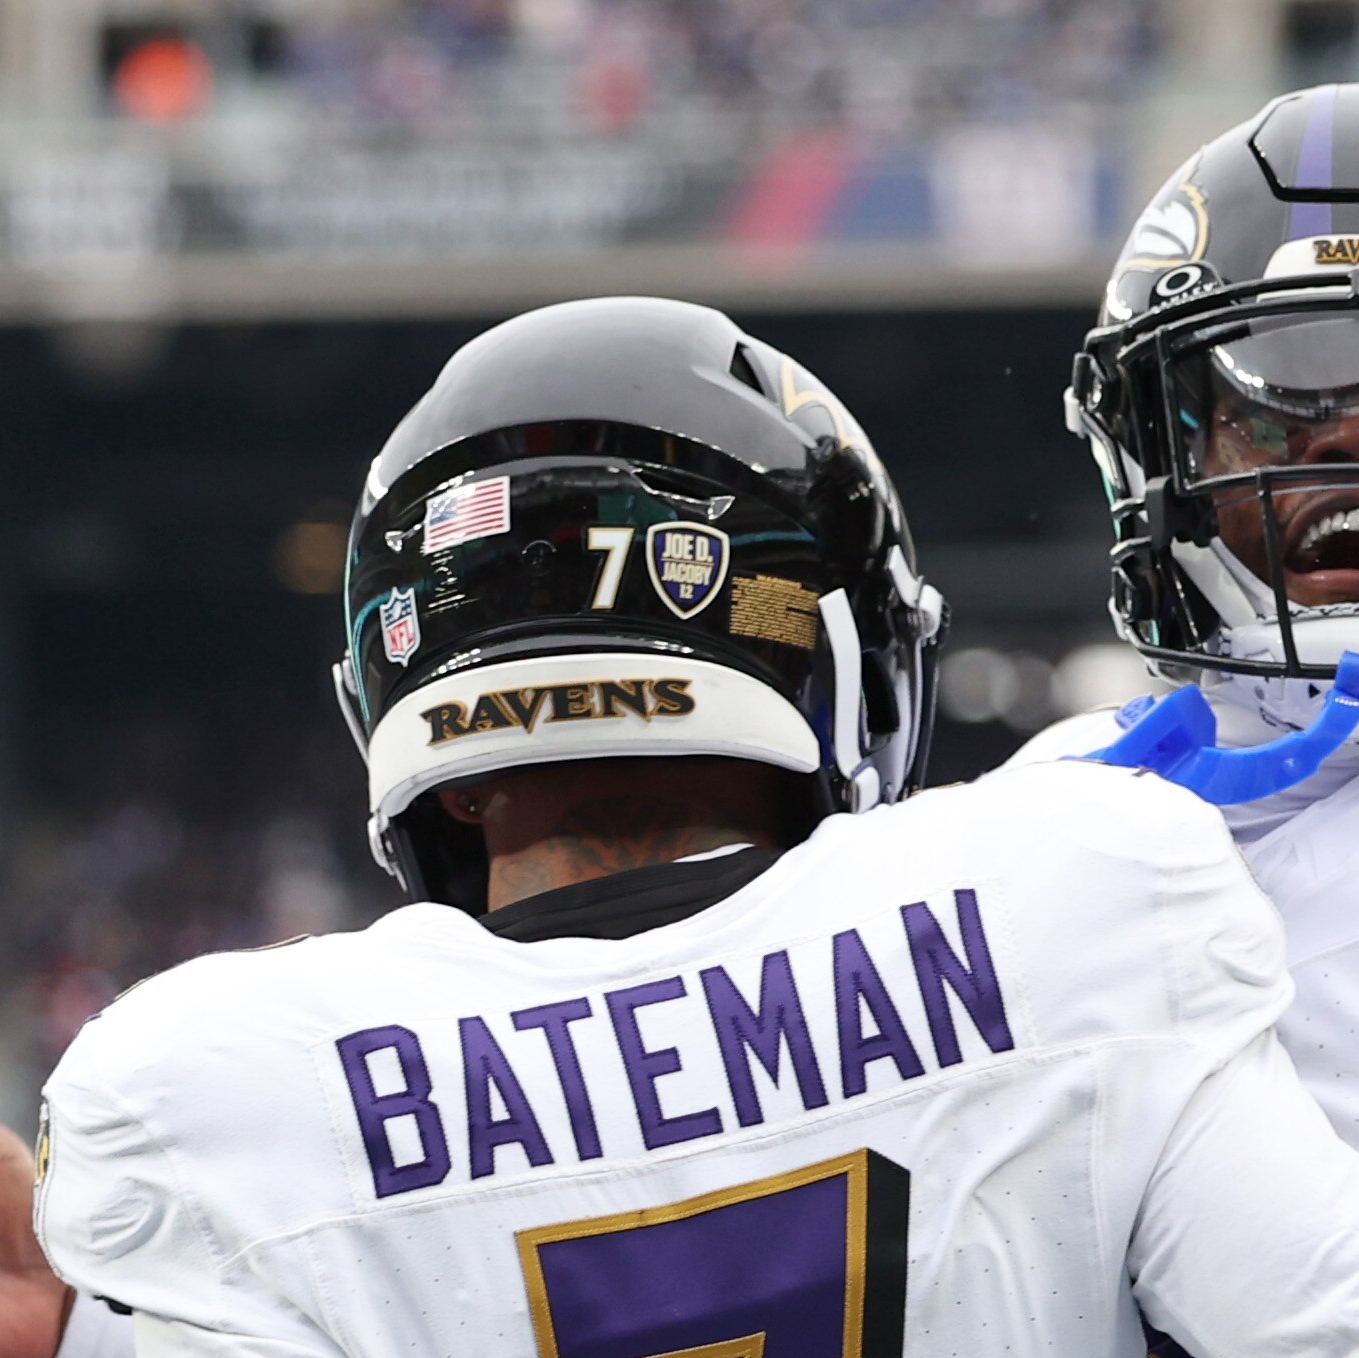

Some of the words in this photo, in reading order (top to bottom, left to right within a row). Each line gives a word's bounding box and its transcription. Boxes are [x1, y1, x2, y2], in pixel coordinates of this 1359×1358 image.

[587, 527, 634, 610] 7
[661, 561, 713, 586] JACOBY
[662, 533, 694, 560] JOE
[696, 536, 714, 563] D.
[420, 678, 696, 747] RAVENS
[335, 888, 1013, 1199] BATEMAN
